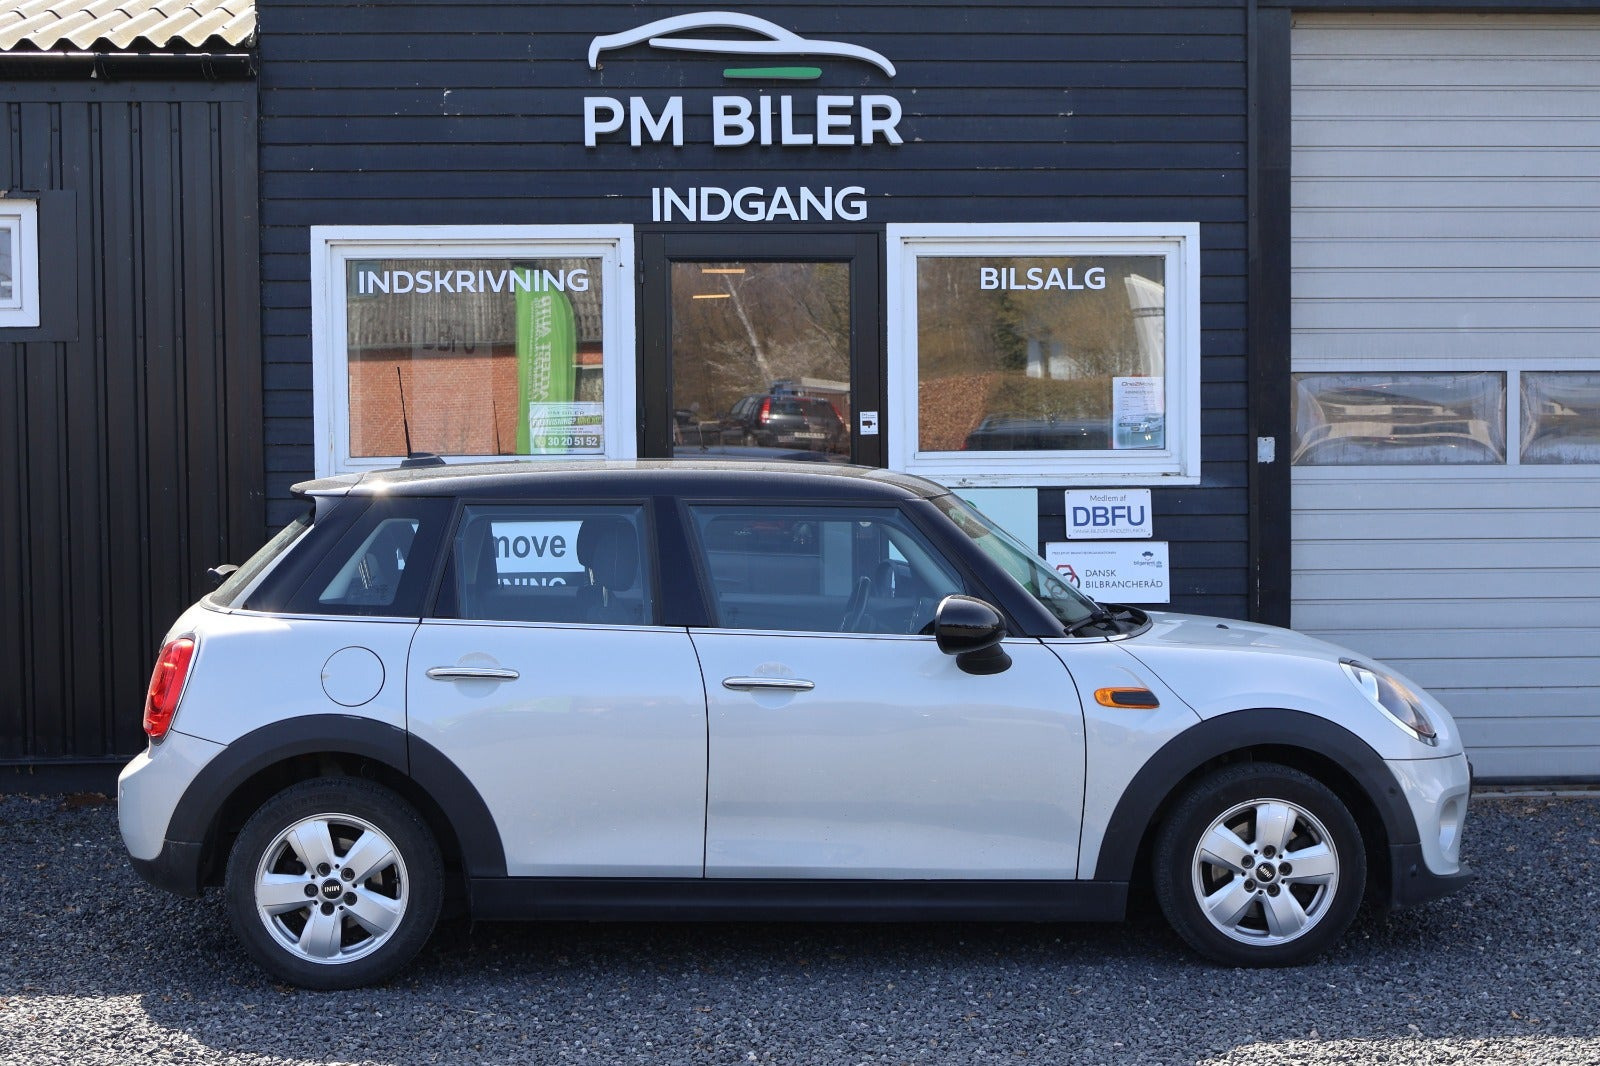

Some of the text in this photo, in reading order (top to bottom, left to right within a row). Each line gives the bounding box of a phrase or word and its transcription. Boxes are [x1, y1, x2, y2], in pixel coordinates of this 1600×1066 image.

[583, 94, 905, 148] PM BILER
[651, 186, 868, 223] INDGANG
[358, 268, 590, 294] INDSKRIVNING
[979, 267, 1107, 291] BILSALG
[548, 436, 598, 446] 30 20 51 52
[1072, 505, 1145, 527] DBFU
[1085, 569, 1117, 578] DANSK
[1085, 580, 1164, 588] BILBRANCHERÅD
[1259, 865, 1273, 879] MINI
